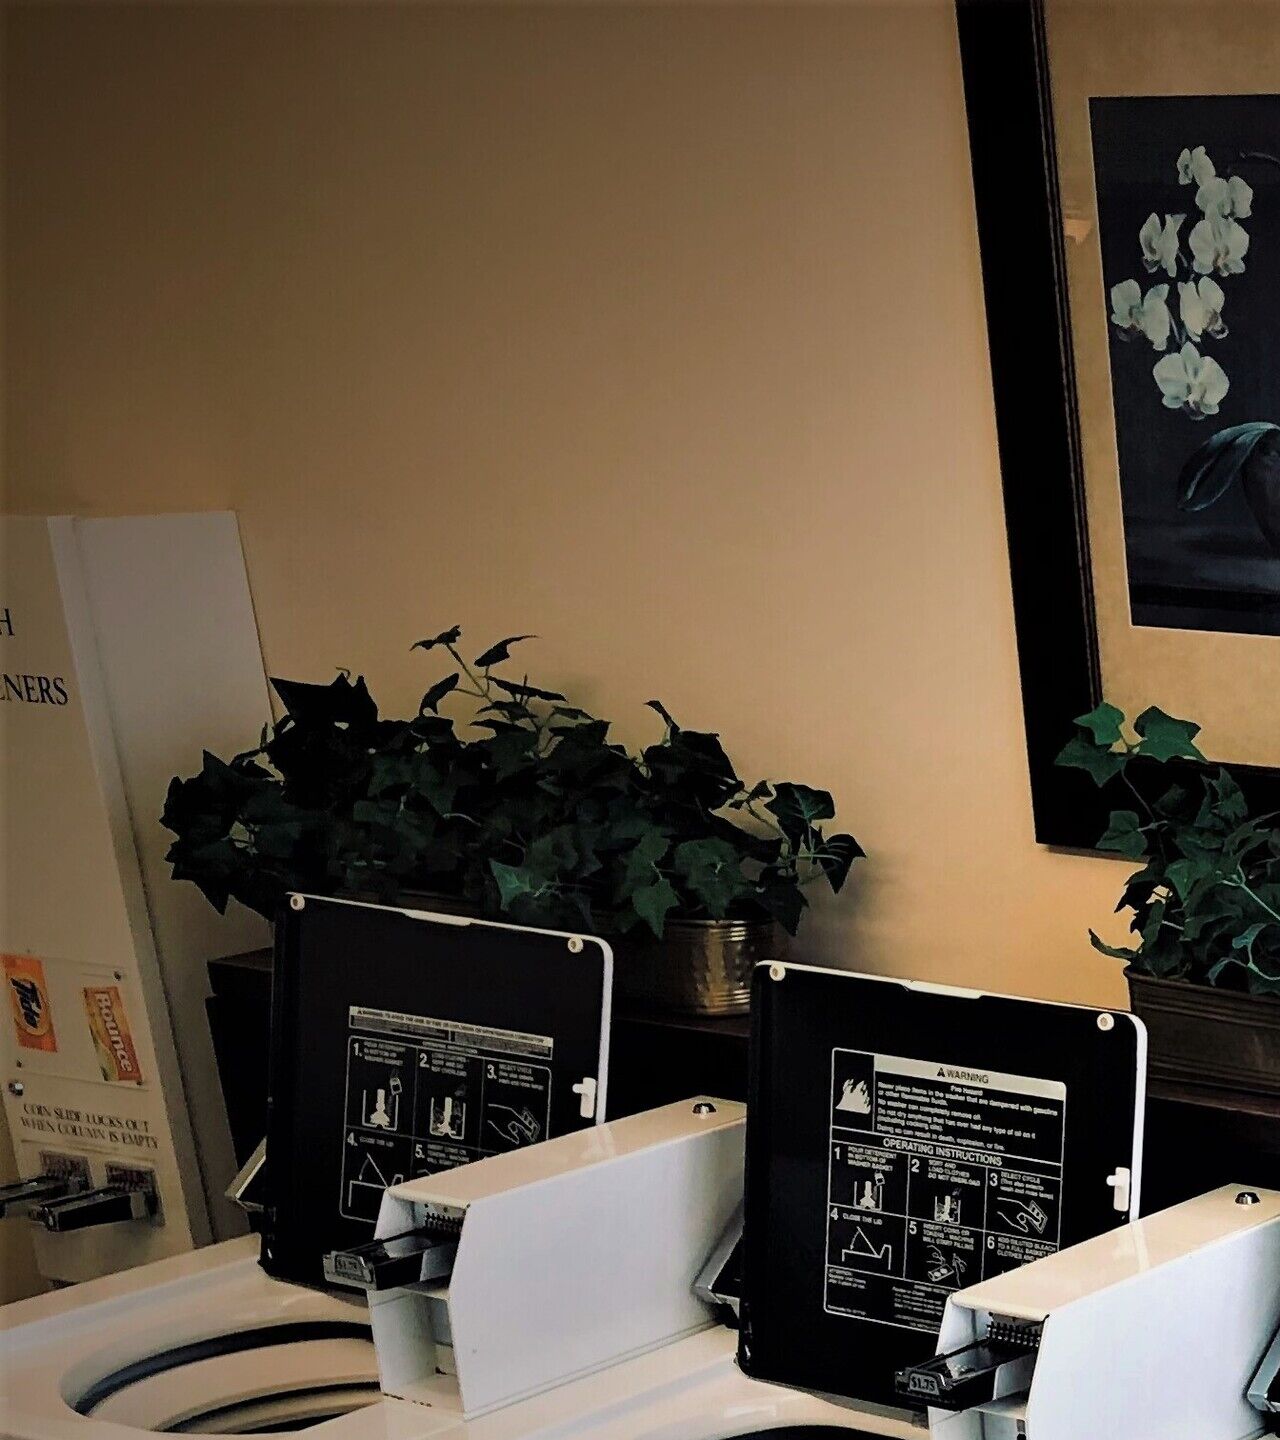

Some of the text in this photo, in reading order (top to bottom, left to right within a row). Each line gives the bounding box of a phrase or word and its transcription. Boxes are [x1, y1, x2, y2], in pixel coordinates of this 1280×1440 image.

[0, 673, 69, 706] NERS
[10, 977, 42, 1029] Tide
[95, 991, 133, 1073] Bounce
[947, 1069, 989, 1084] WARNING
[121, 1132, 160, 1149] EMPTY
[834, 1146, 841, 1160] 1
[883, 1138, 1003, 1166] OPERATING INSTRUCTIONS
[911, 1158, 920, 1173] 2
[989, 1172, 998, 1187] 3
[830, 1208, 839, 1221] 4
[909, 1220, 918, 1235] 5
[987, 1235, 995, 1250] 6
